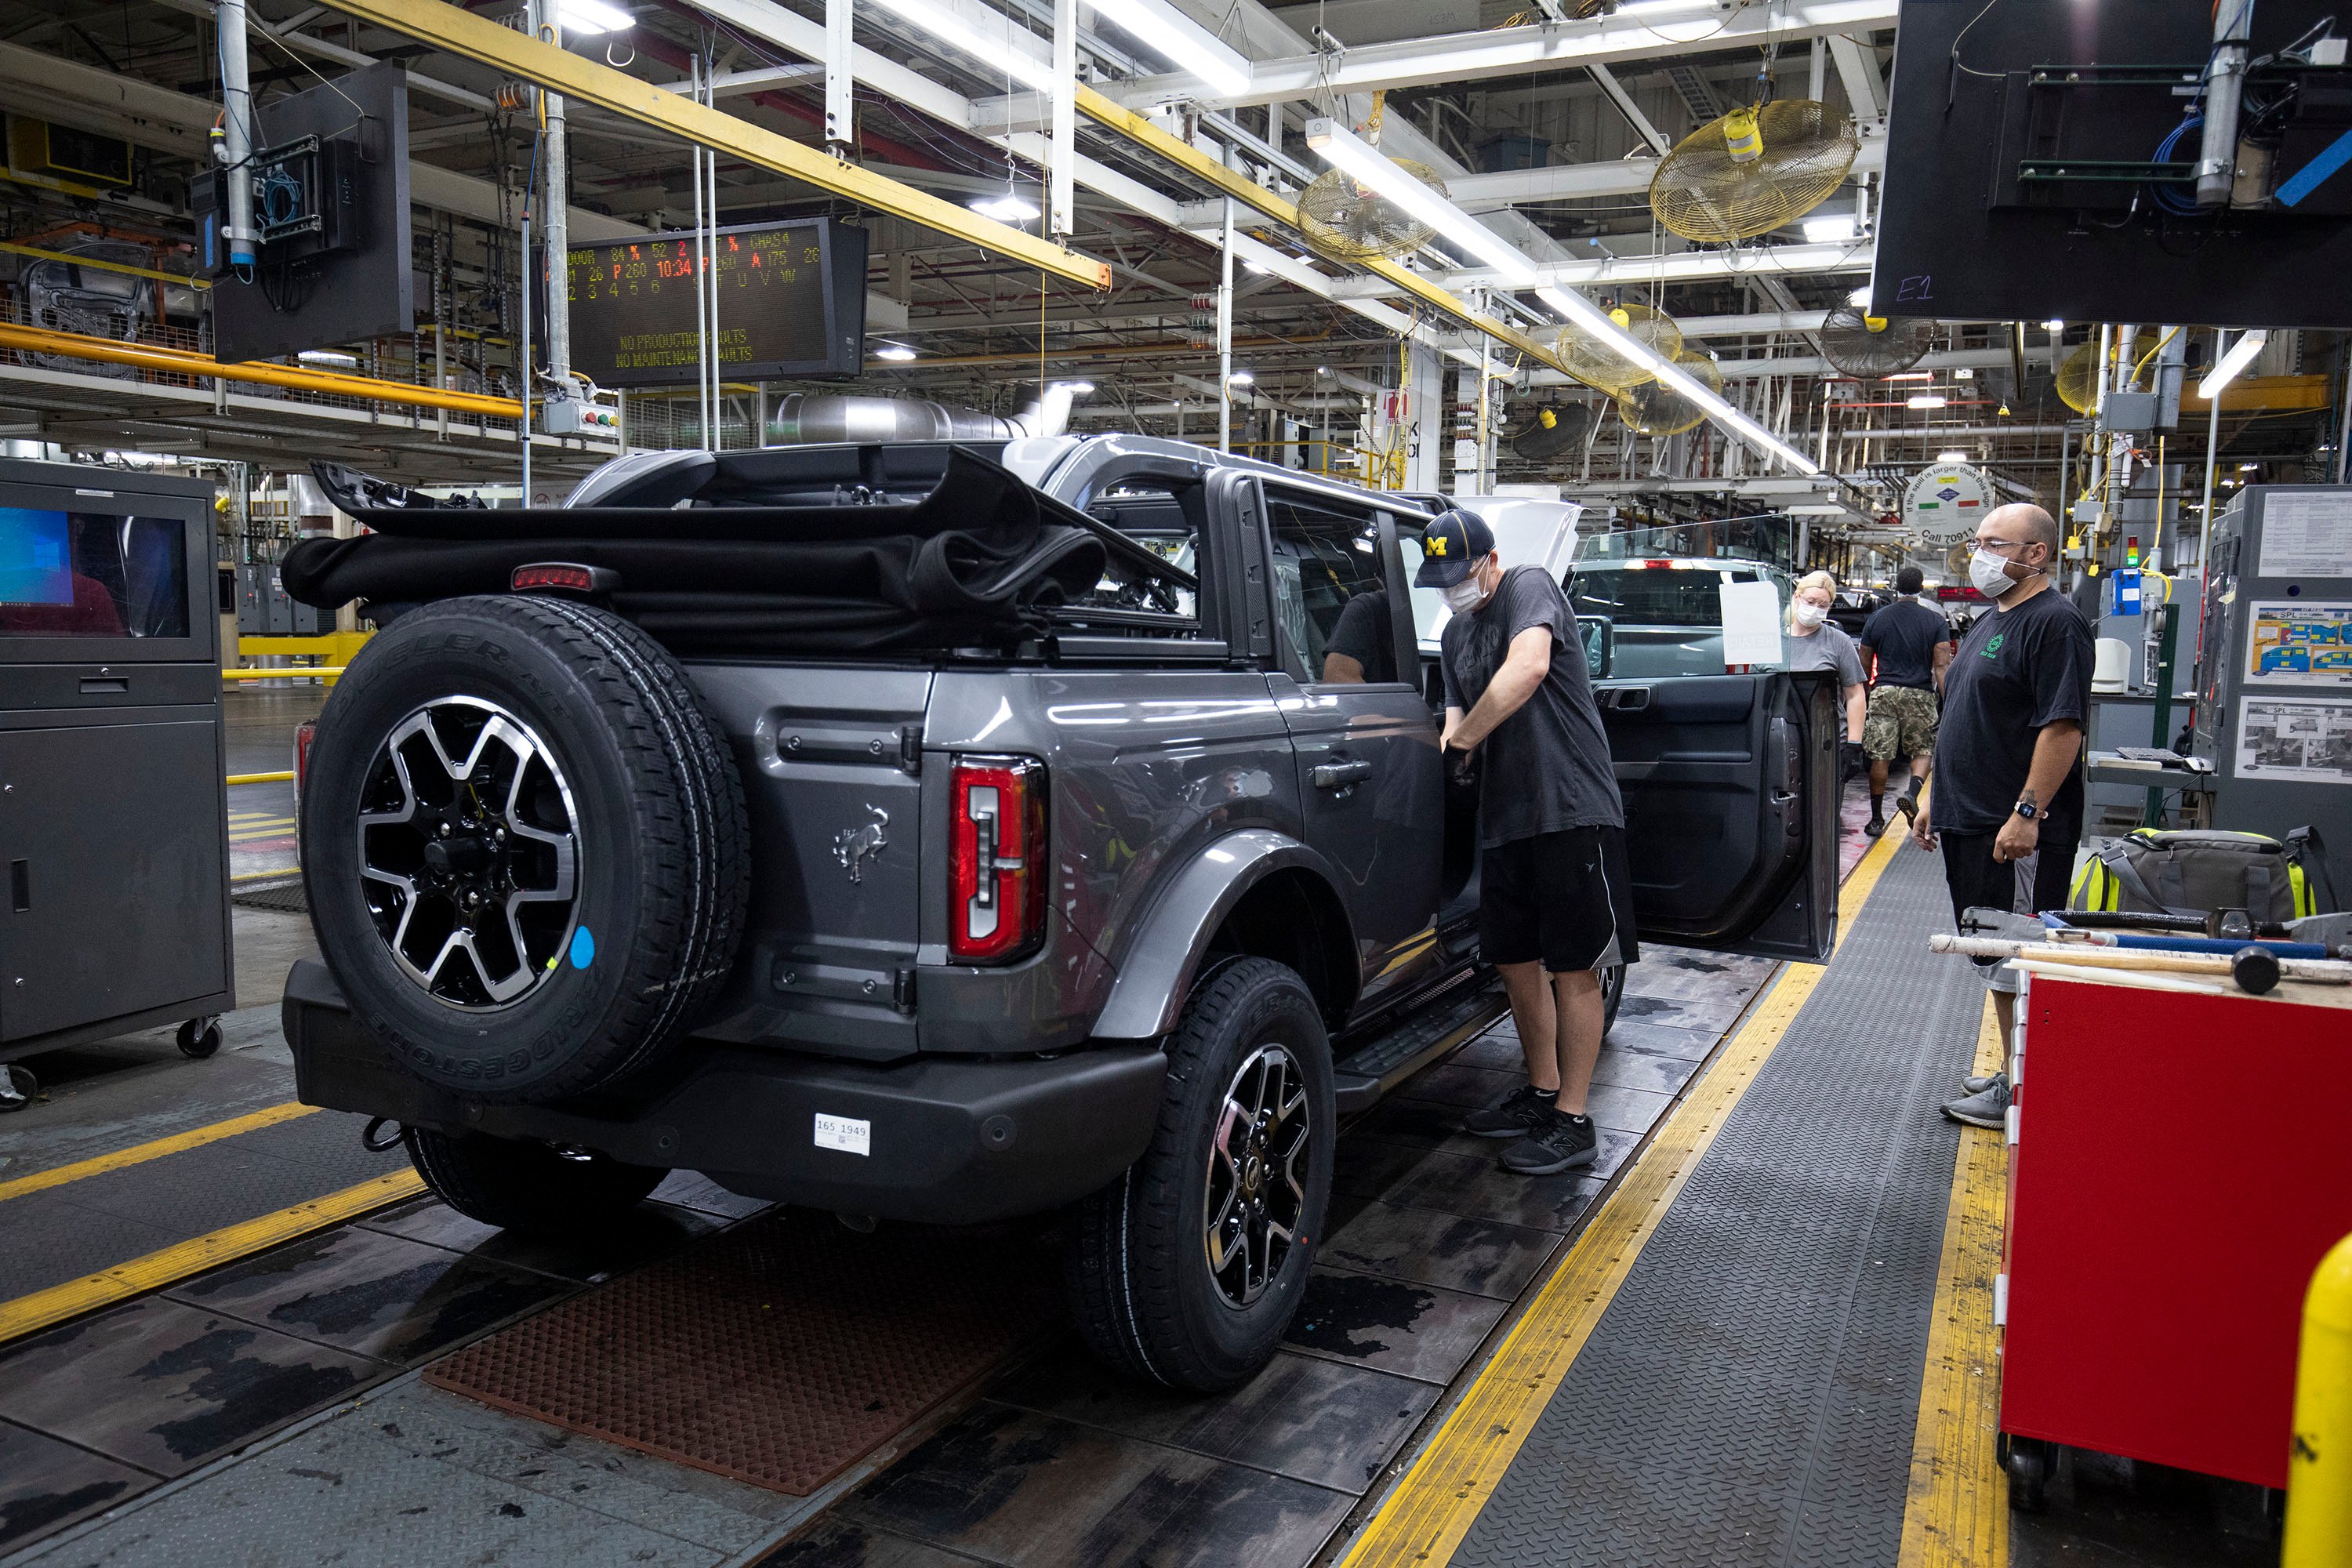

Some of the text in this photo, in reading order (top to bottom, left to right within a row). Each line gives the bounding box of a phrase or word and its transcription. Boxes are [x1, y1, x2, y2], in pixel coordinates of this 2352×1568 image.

[652, 243, 667, 258] 52
[677, 241, 687, 256] 2
[589, 267, 603, 281] 26
[613, 264, 622, 280] P
[626, 263, 647, 278] 260
[657, 259, 692, 277] 10:34
[751, 252, 761, 267] A
[568, 286, 576, 300] 2
[588, 285, 597, 299] 3
[609, 282, 619, 297] 4
[738, 272, 746, 287] U
[760, 270, 771, 285] V
[1896, 274, 1935, 302] E1
[620, 336, 634, 350] NO
[706, 329, 746, 345] FULTS
[616, 347, 753, 368] NO MAINTENANC AULTS
[1907, 493, 1915, 506] the
[1912, 477, 1925, 492] spill
[1933, 466, 1957, 475] larger
[1959, 466, 1976, 478] than
[1976, 477, 1987, 491] this
[1922, 527, 1975, 544] Call 70911
[1426, 537, 1447, 556] M
[817, 1120, 836, 1131] 165
[841, 1124, 866, 1137] 1949
